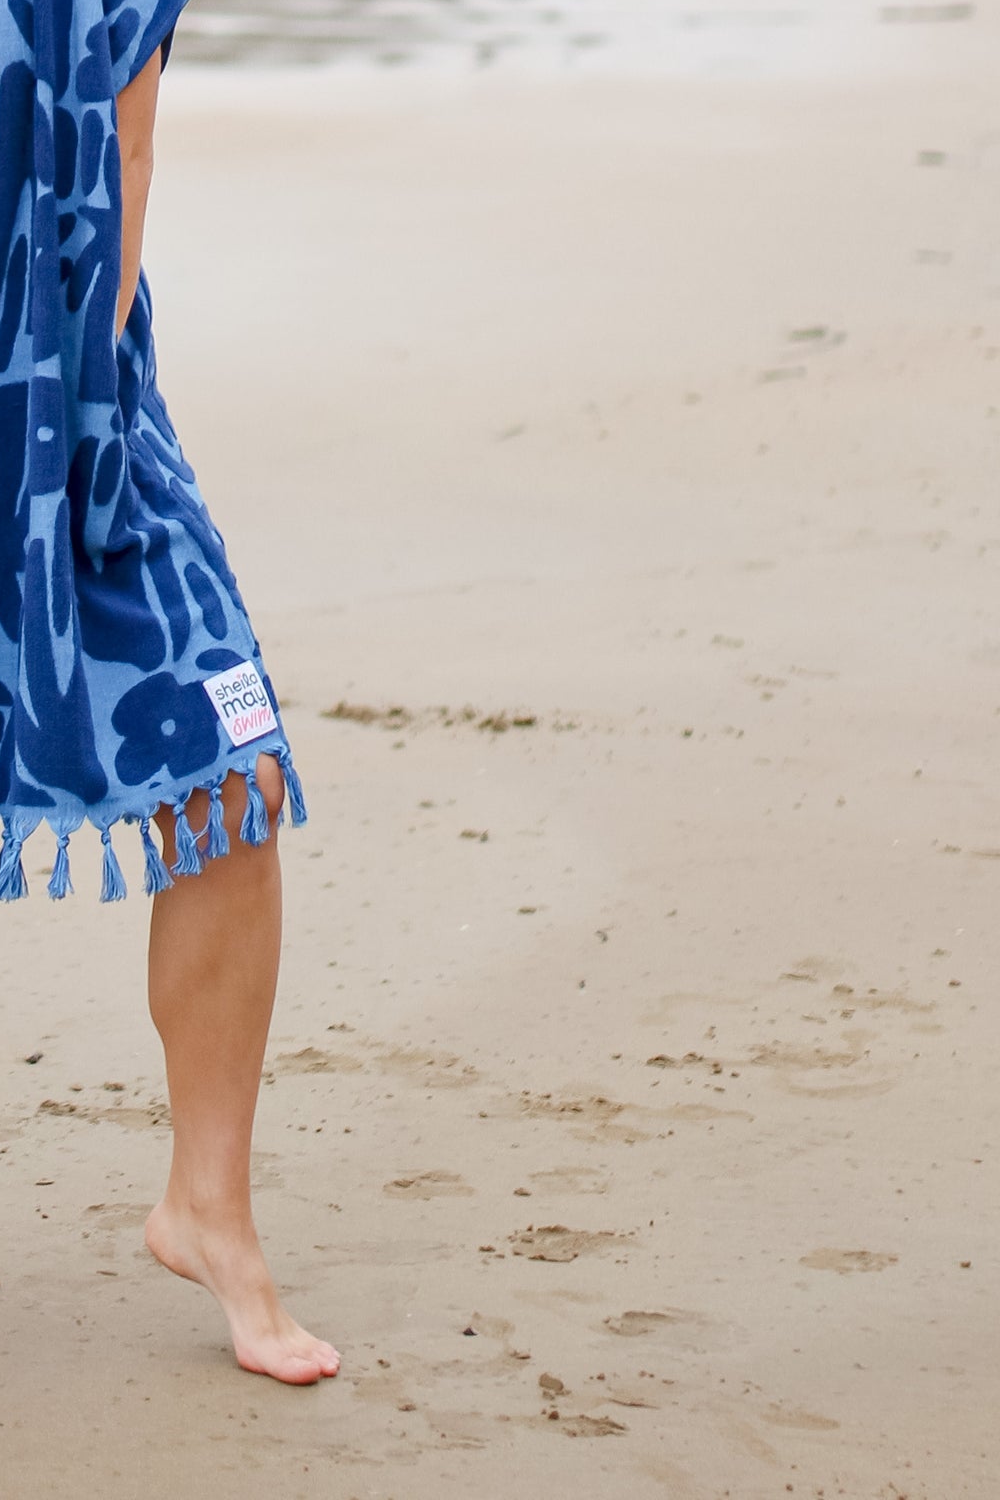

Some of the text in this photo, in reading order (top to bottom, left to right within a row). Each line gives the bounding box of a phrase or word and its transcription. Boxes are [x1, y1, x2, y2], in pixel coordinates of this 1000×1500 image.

[214, 673, 258, 700] sheila
[221, 685, 267, 718] may
[233, 707, 271, 737] swim
